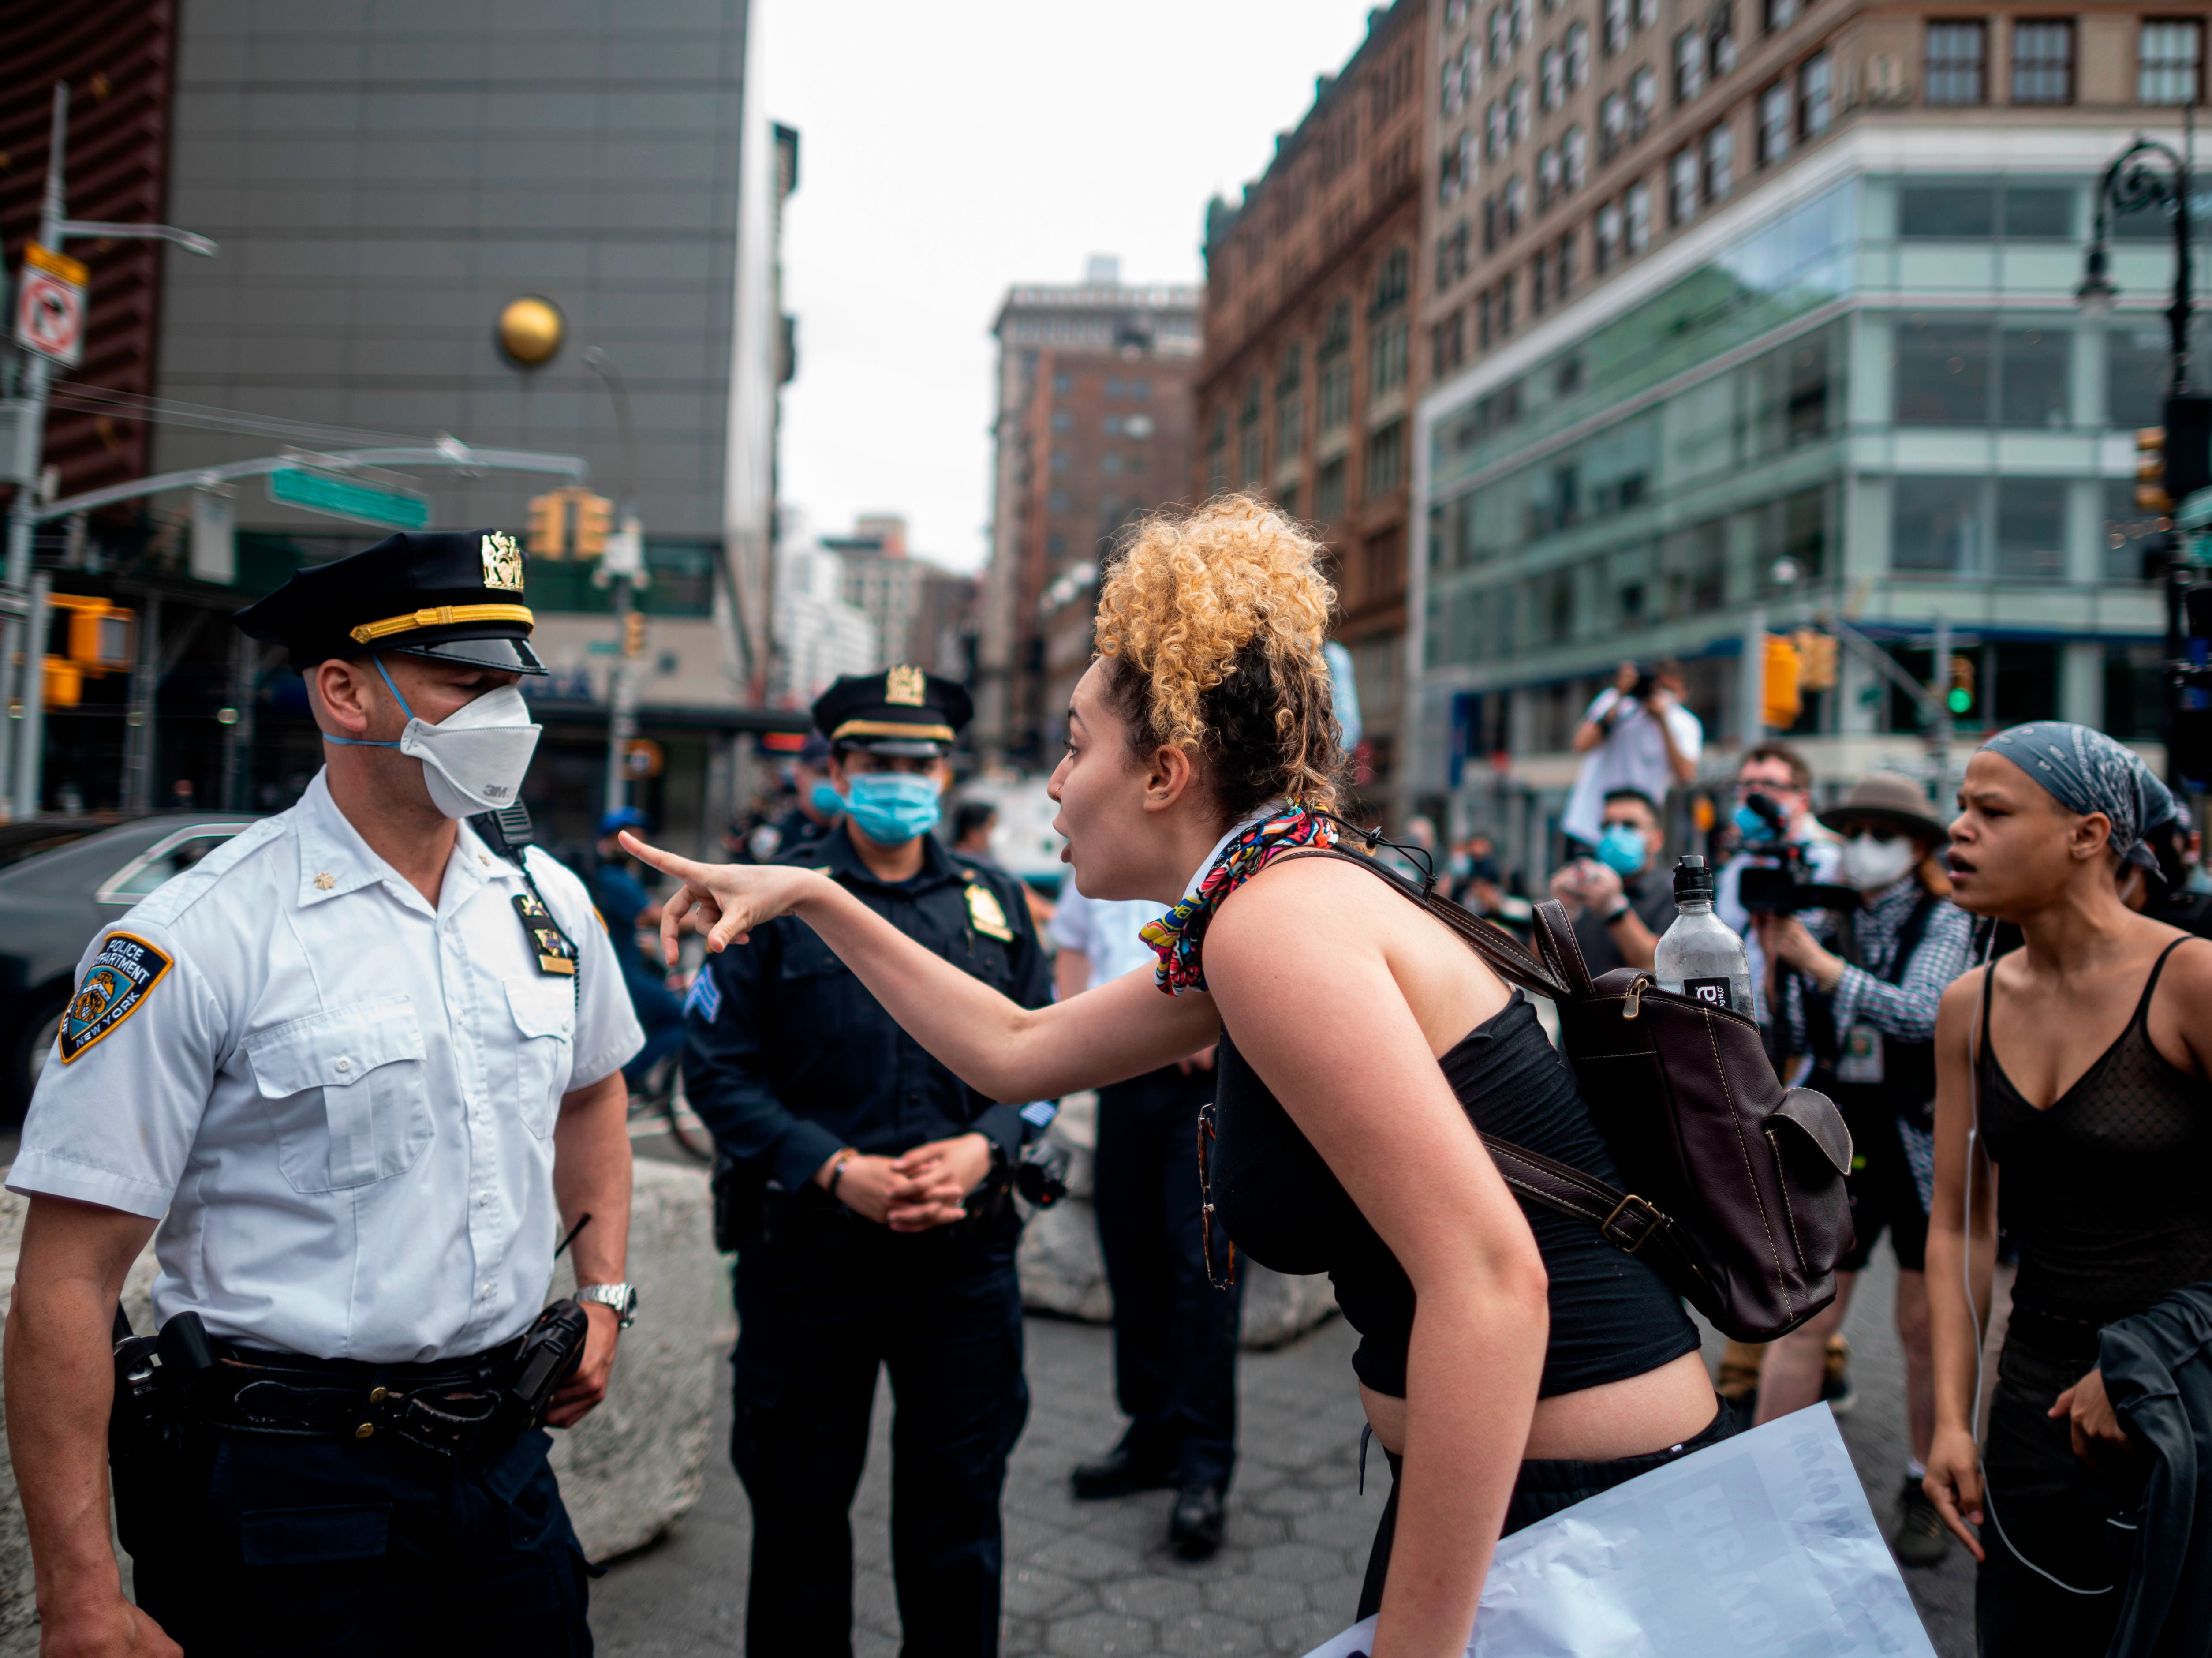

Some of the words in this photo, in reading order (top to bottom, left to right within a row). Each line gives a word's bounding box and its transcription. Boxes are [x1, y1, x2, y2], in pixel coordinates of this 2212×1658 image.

[483, 784, 508, 798] 3M
[106, 939, 144, 961] POLICE
[75, 1023, 101, 1048] NEW
[102, 992, 140, 1025] YORK
